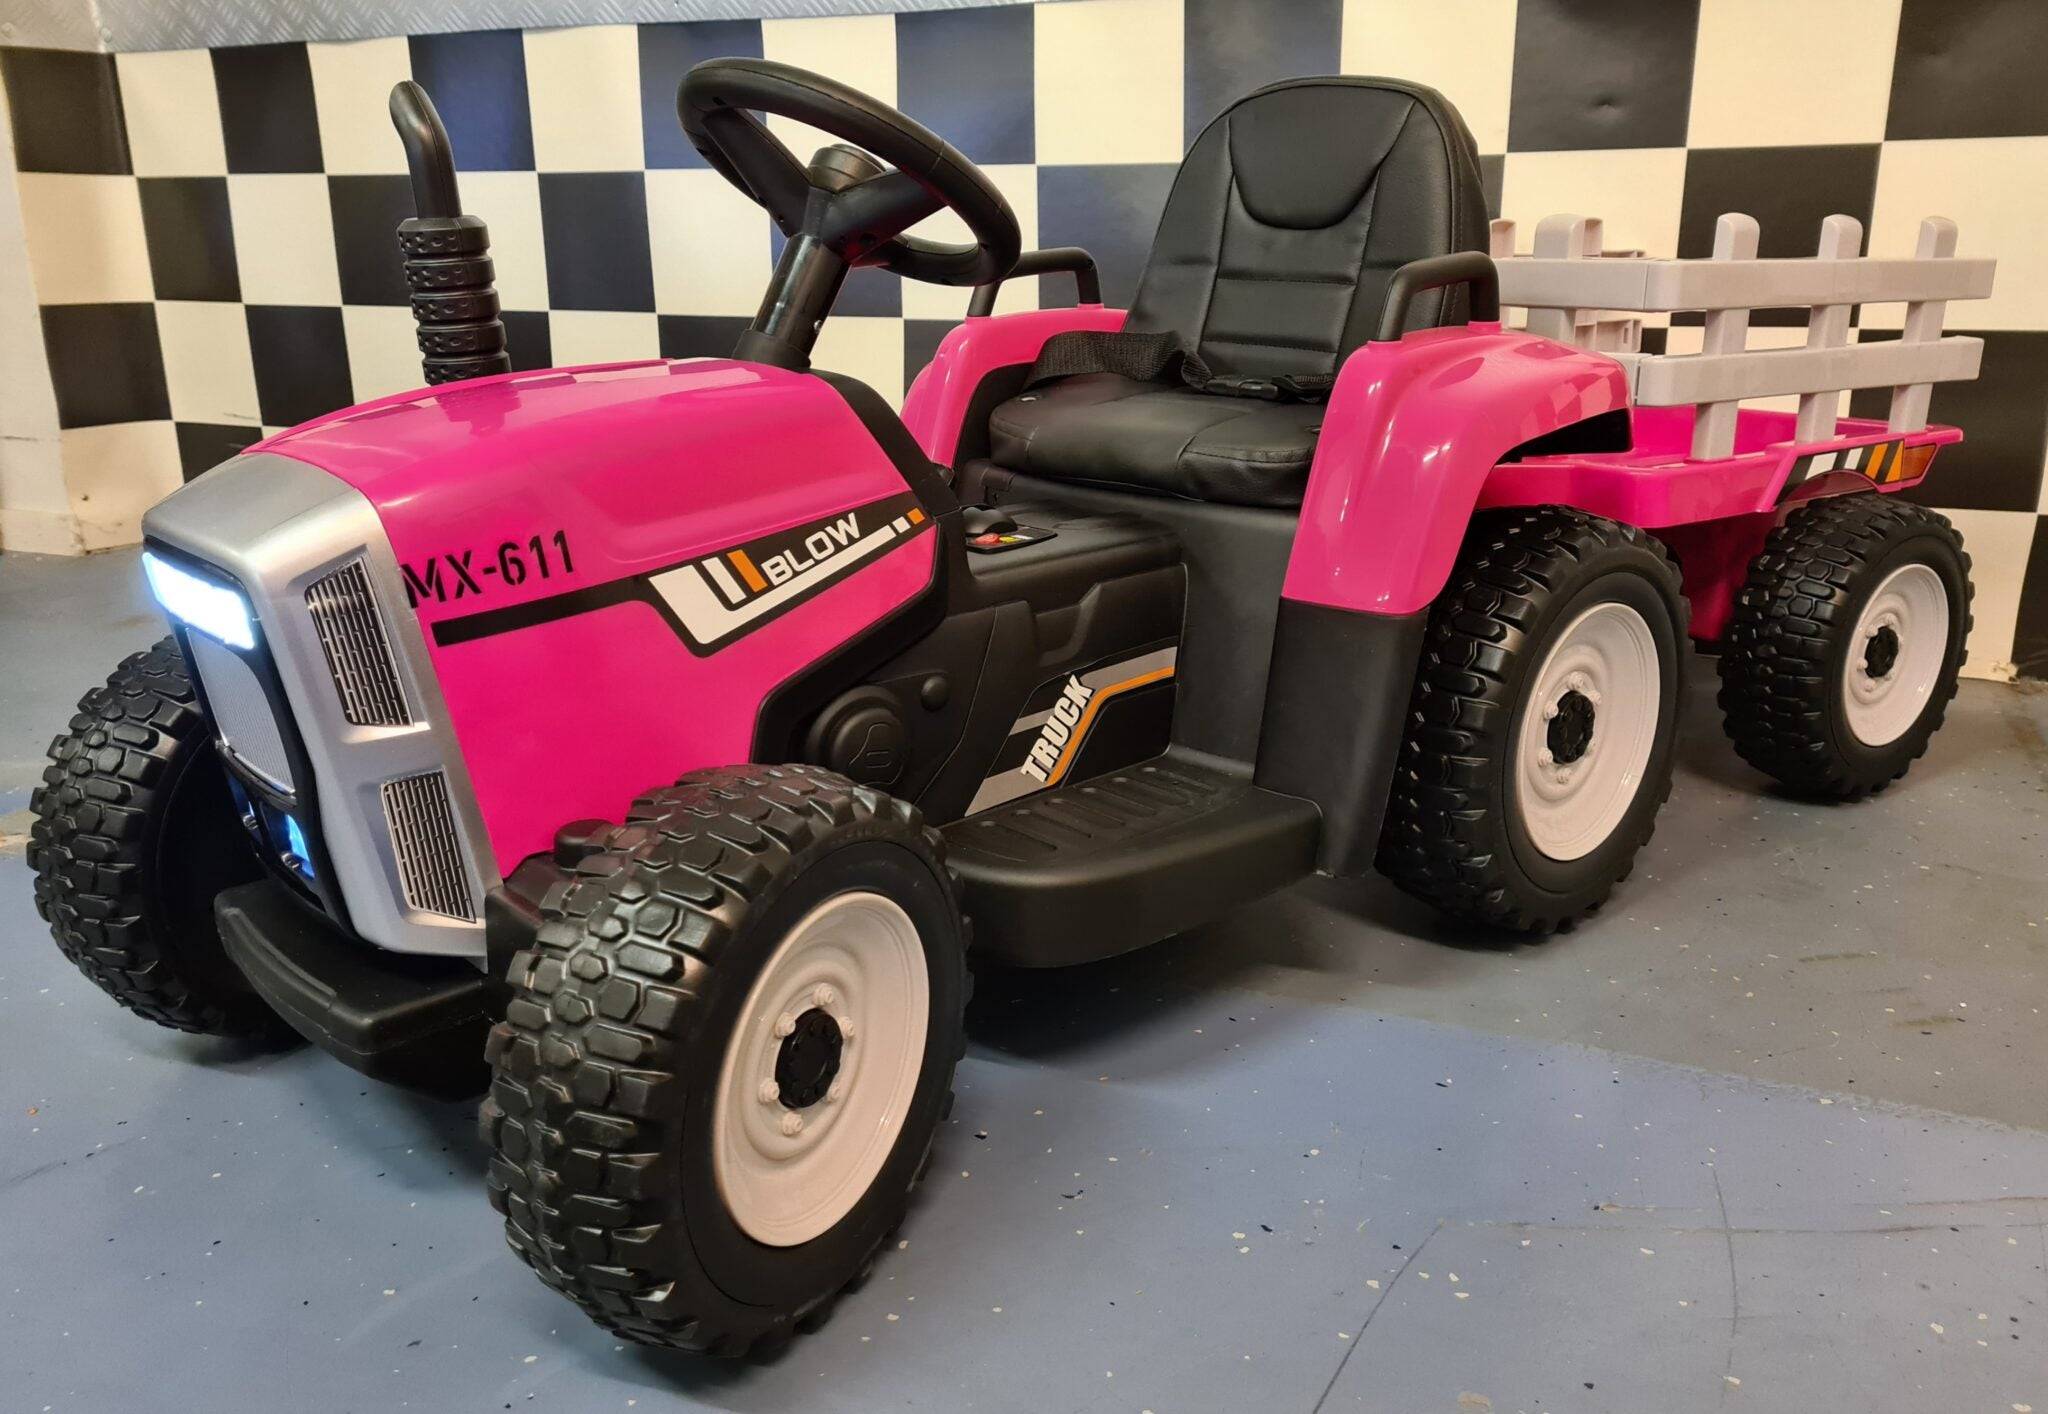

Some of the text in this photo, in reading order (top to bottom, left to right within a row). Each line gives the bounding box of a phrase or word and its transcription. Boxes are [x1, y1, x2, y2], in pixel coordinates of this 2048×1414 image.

[402, 530, 574, 609] MX-611
[761, 512, 861, 585] BLOW
[1021, 674, 1094, 783] TRUCK
